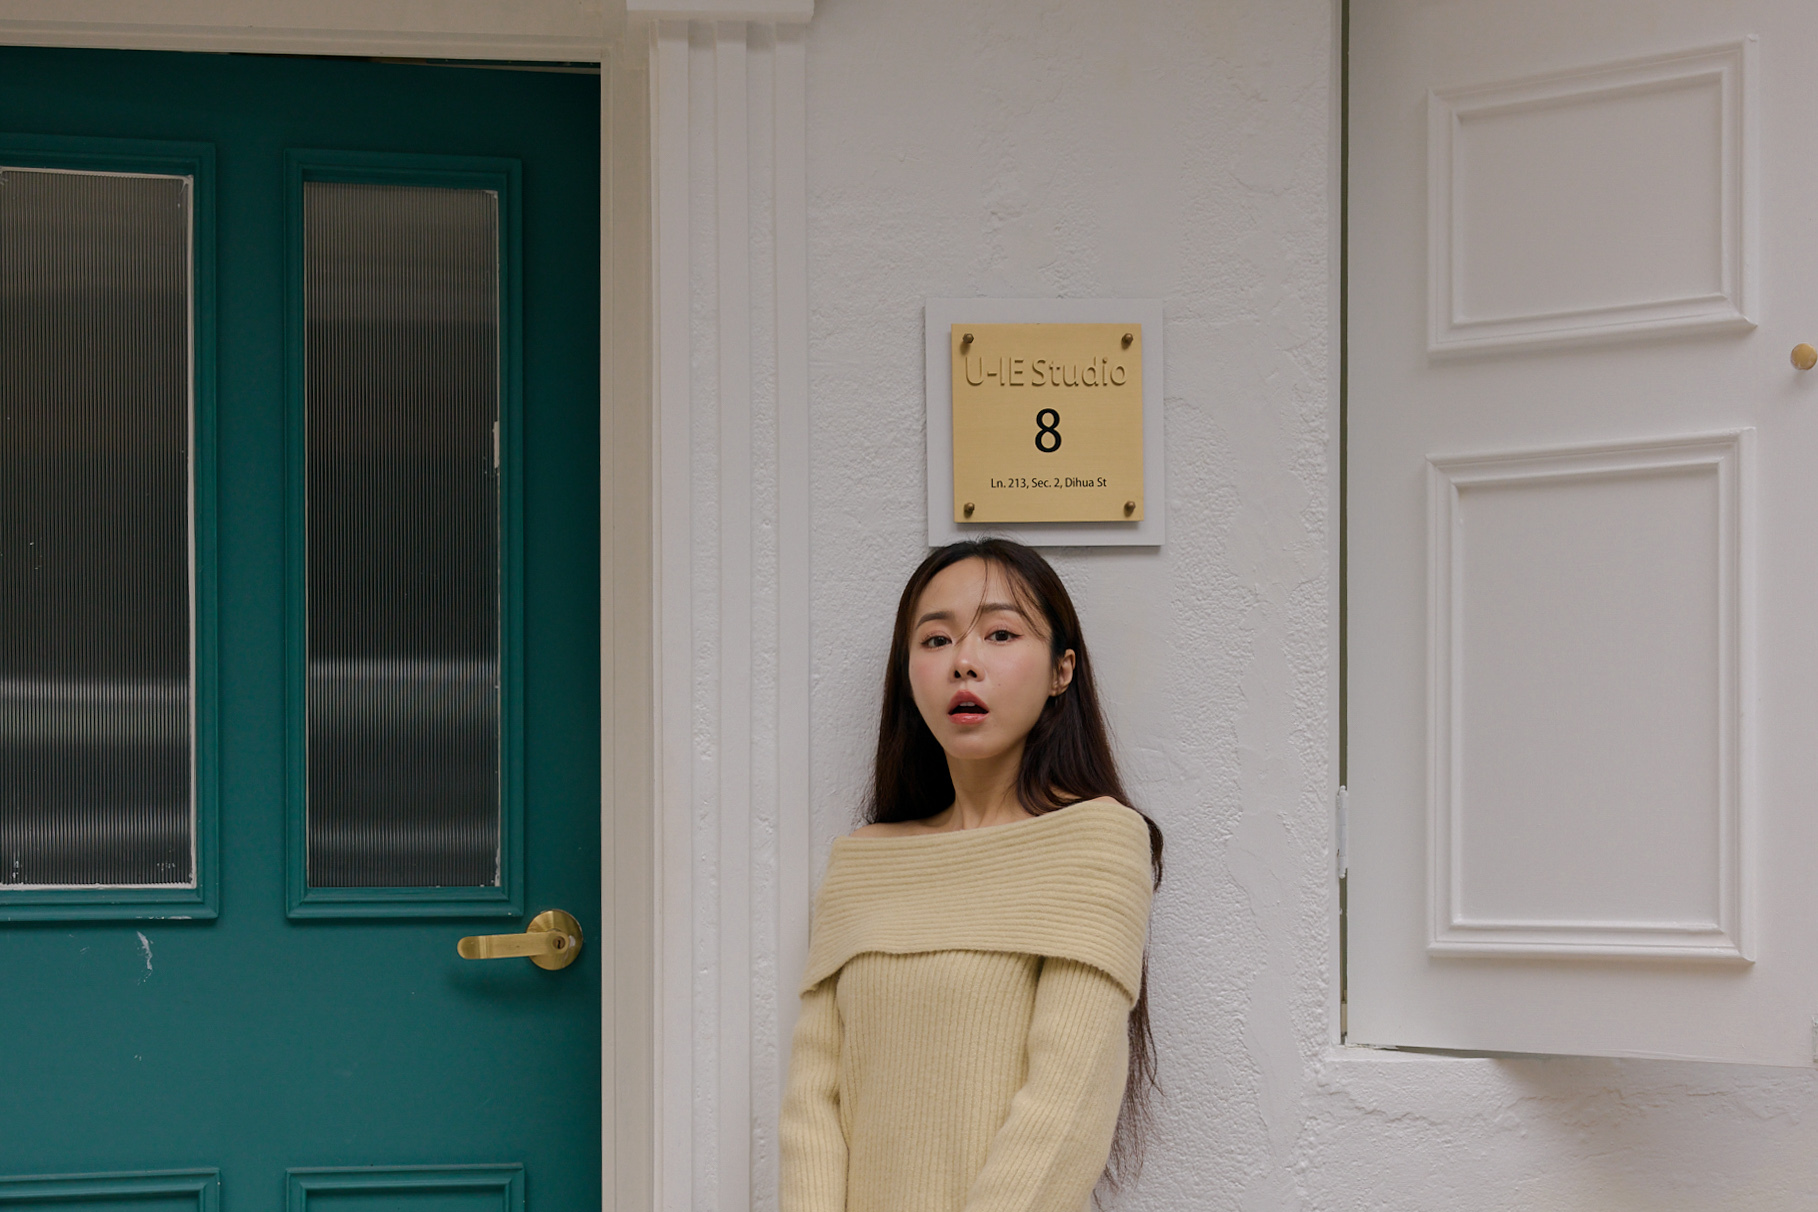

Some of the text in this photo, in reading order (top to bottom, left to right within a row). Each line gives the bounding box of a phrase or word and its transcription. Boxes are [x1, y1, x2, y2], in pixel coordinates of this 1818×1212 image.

[965, 356, 1128, 388] U-IE Studio
[1034, 408, 1062, 453] 8
[991, 477, 1107, 490] Ln. 213, Sec. 2, Dihua St
